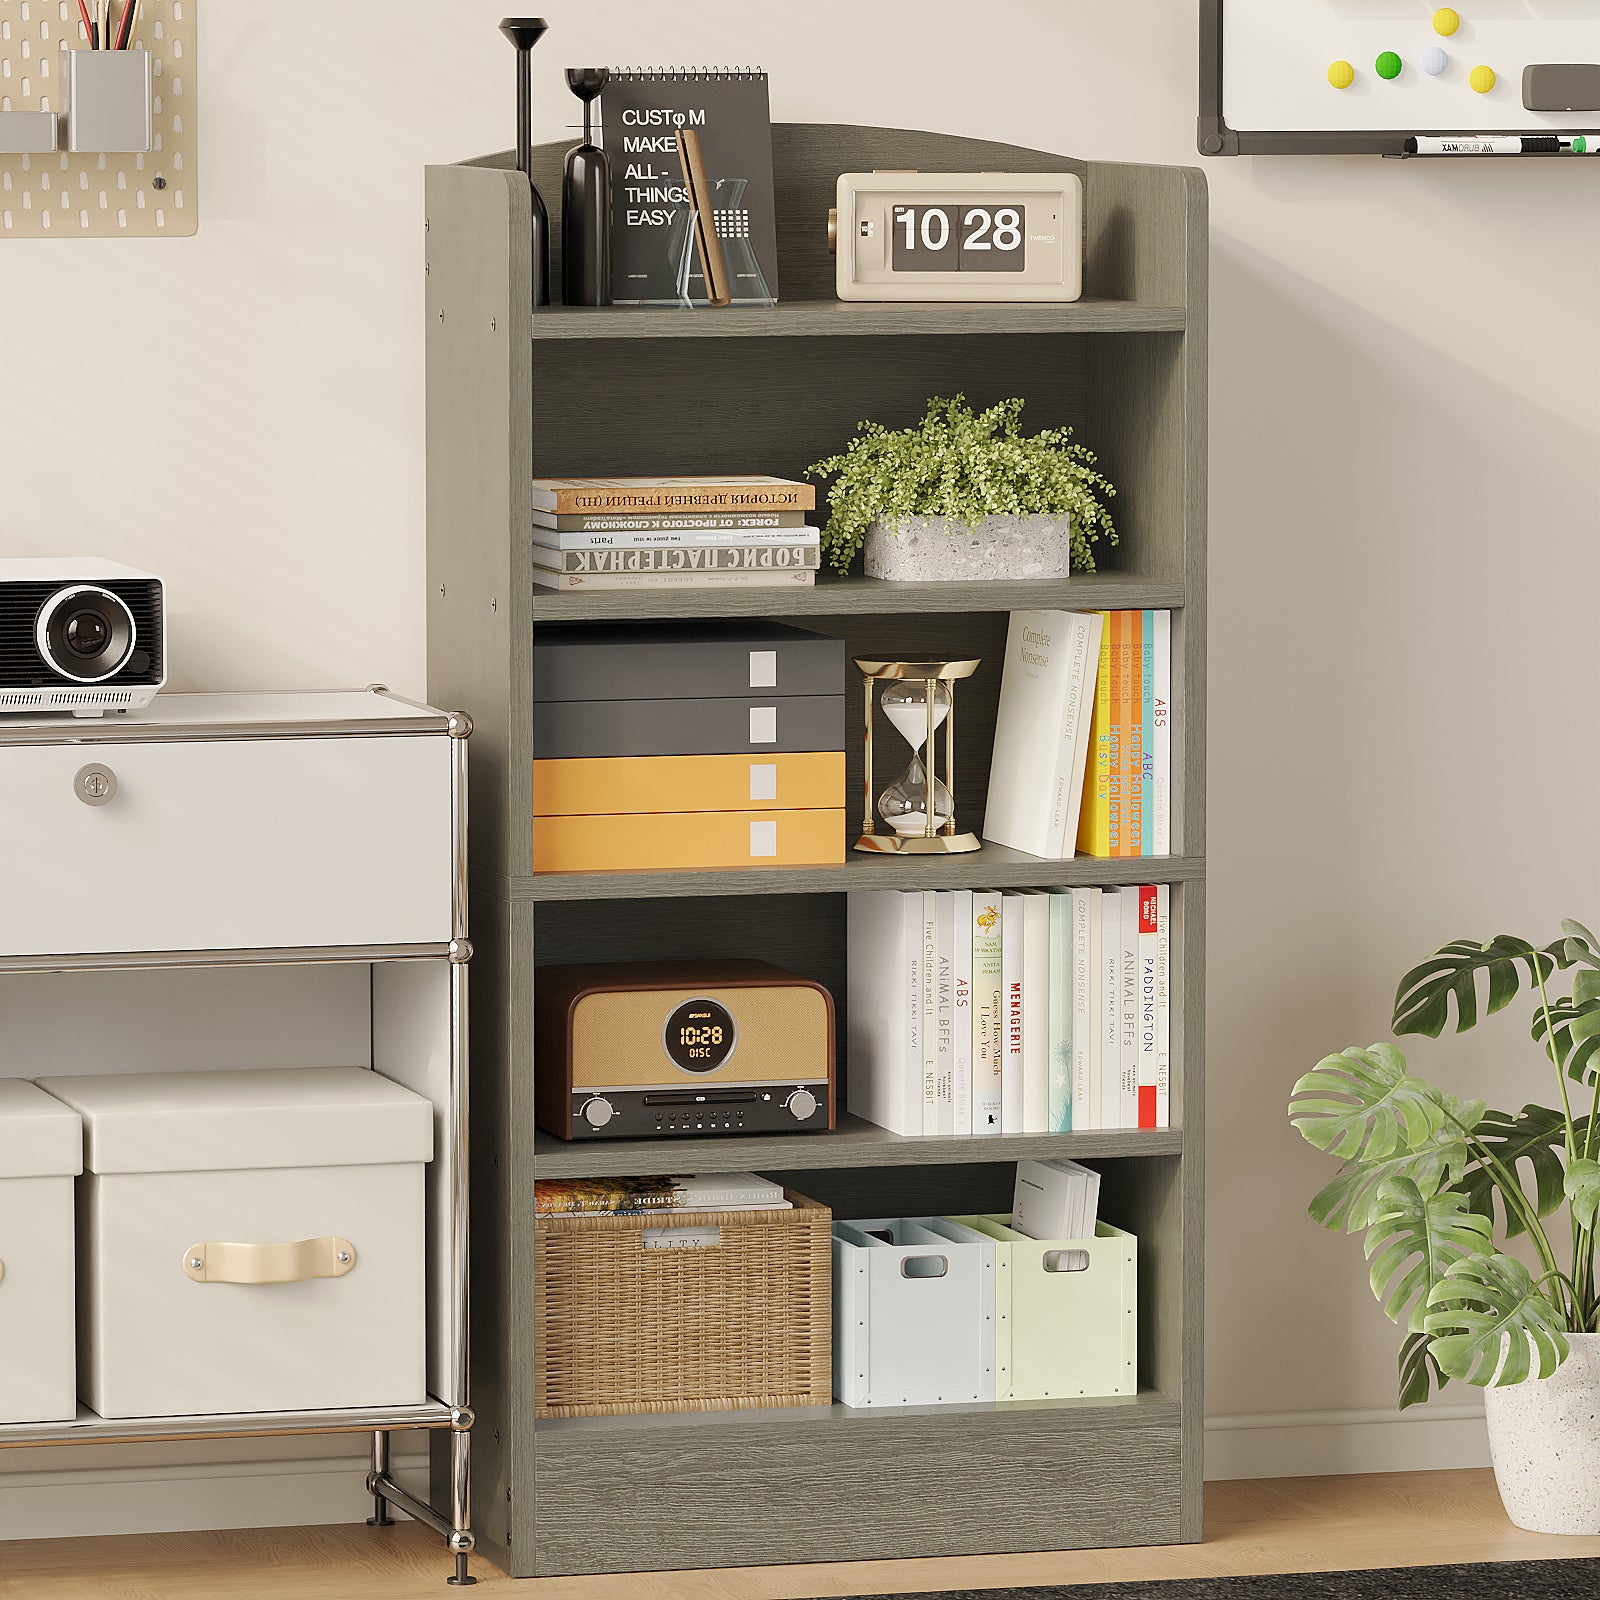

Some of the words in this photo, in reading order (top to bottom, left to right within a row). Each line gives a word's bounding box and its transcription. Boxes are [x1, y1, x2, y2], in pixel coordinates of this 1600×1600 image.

[623, 136, 681, 153] MAKE
[624, 163, 658, 180] ALL
[626, 209, 677, 226] EASY
[896, 208, 949, 251] 10
[963, 208, 1021, 251] 28
[606, 495, 661, 507] ГРЕЦИИ
[664, 493, 729, 507] ДРЕВНЕЙ
[730, 492, 798, 506] ИСТОРИЯ
[583, 519, 649, 531] СЛОЖНОМУ
[651, 519, 660, 529] К
[662, 518, 716, 529] ПРОСТОГО
[719, 518, 733, 528] ОТ
[589, 537, 613, 546] Paris
[574, 549, 718, 571] ПАСТЕРНАК
[728, 547, 805, 567] БОРИС
[1022, 626, 1051, 648] Complete
[1019, 647, 1049, 668] Nonsense
[1072, 625, 1085, 681] COMPLETE
[1065, 685, 1078, 740] NONSENSE
[1155, 698, 1166, 728] ABS
[1143, 752, 1153, 780] ABC
[925, 921, 933, 940] Five
[1078, 900, 1086, 954] COMPLETE
[1159, 915, 1167, 934] Five
[925, 944, 933, 984] Children
[1159, 937, 1167, 976] Children
[925, 987, 933, 1004] and
[957, 978, 968, 1007] ABS
[1078, 959, 1086, 1014] NONSENSE
[1159, 980, 1167, 997] and
[992, 990, 1001, 1018] Guess
[1143, 958, 1154, 1052] PADDINGTON
[981, 1013, 989, 1037] Love
[1010, 982, 1021, 1054] MENAGERIE
[680, 1025, 723, 1046] 10:28
[992, 1022, 1001, 1045] How
[980, 1040, 989, 1059] You
[992, 1048, 1001, 1076] Much
[925, 1072, 933, 1105] NESBIT
